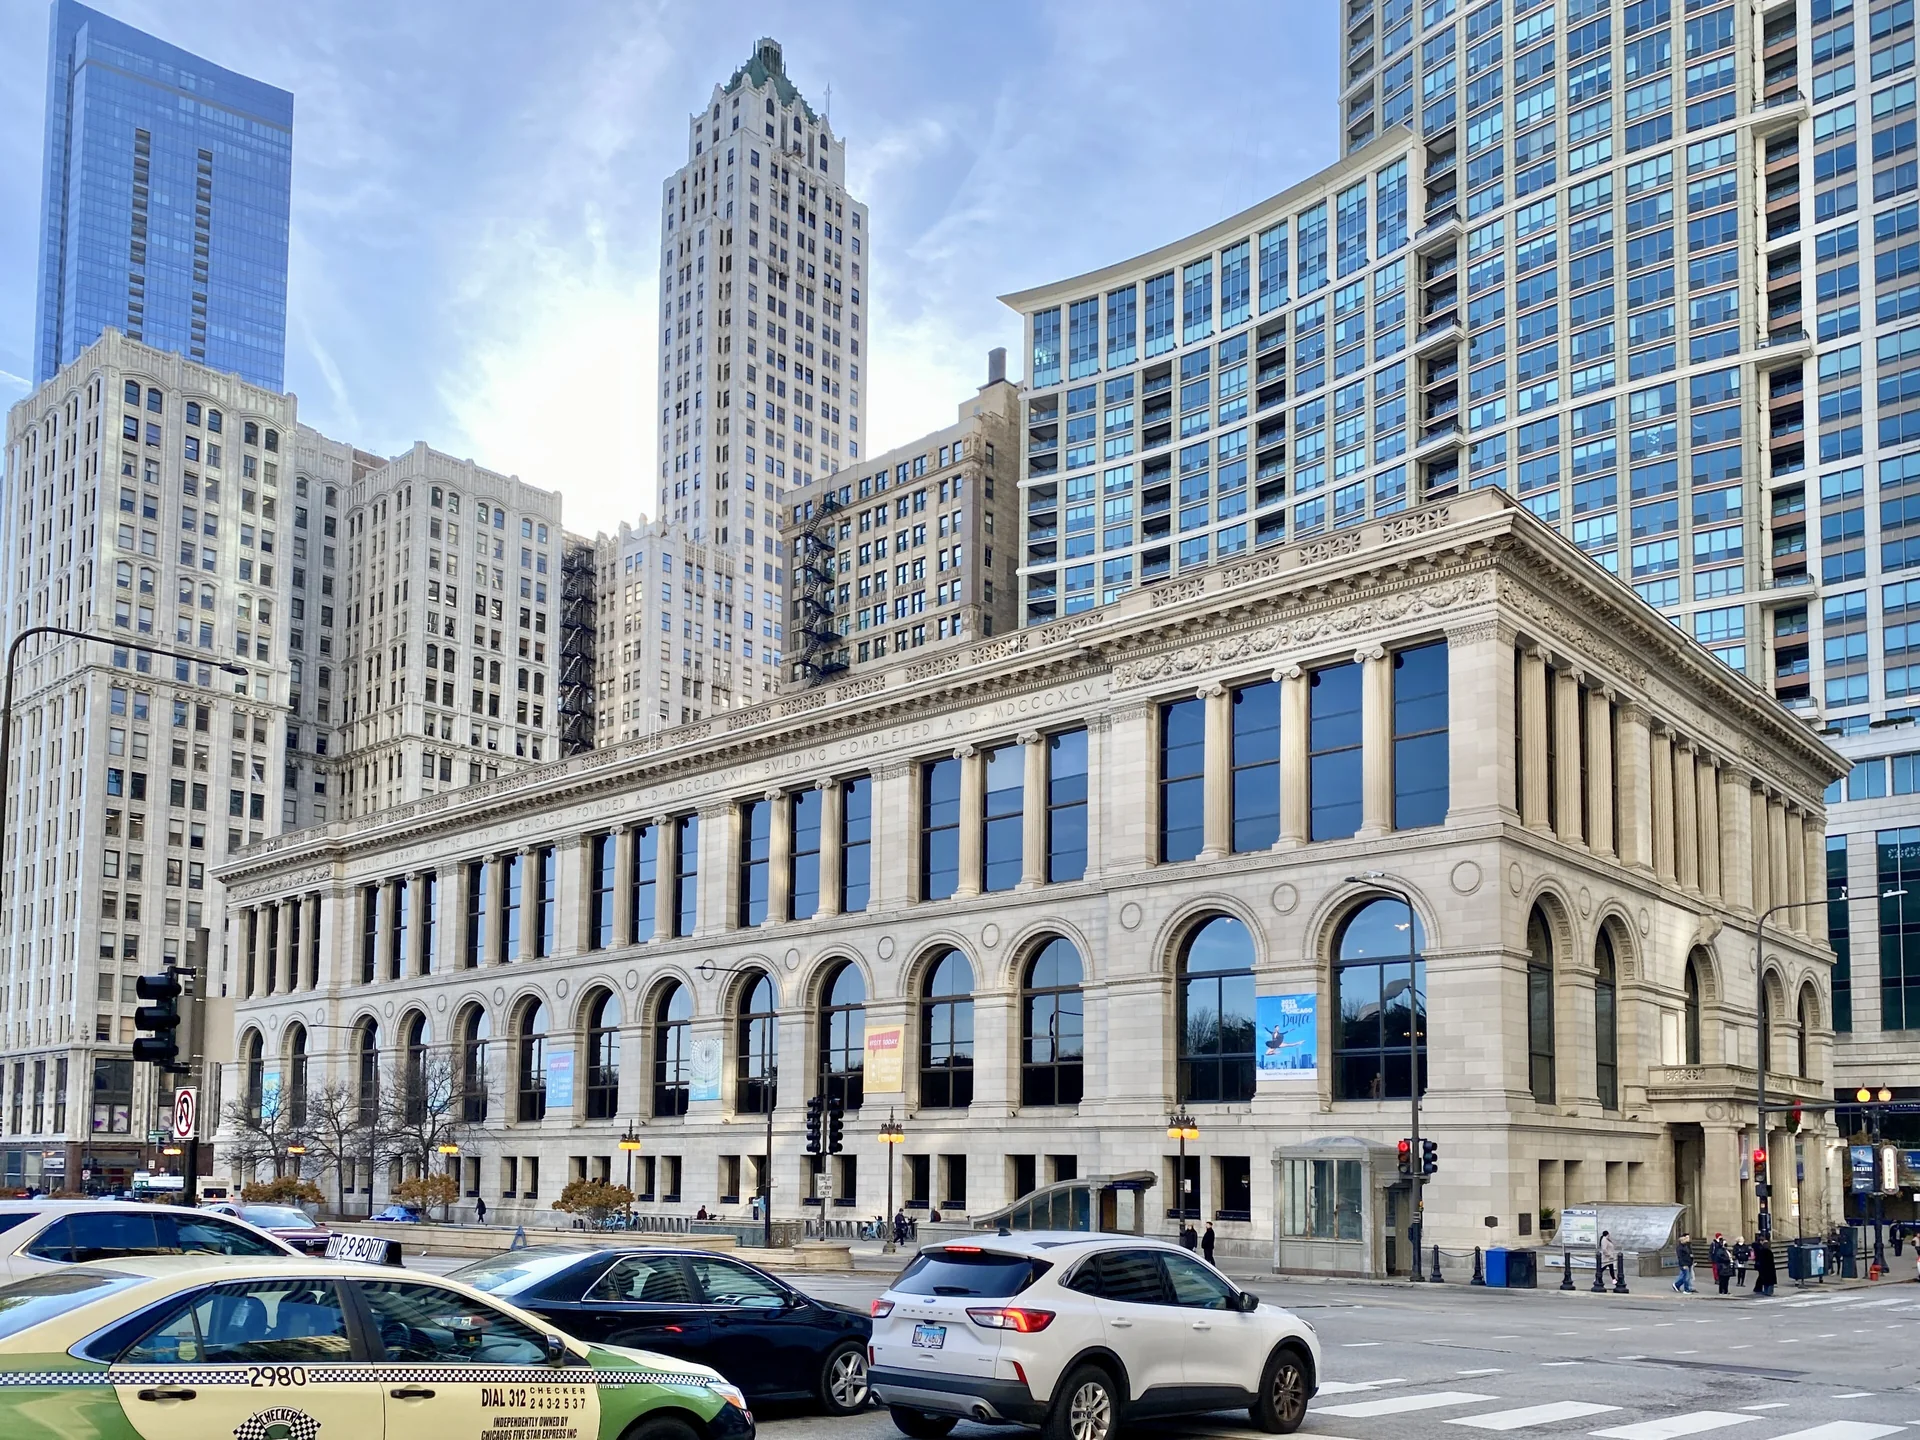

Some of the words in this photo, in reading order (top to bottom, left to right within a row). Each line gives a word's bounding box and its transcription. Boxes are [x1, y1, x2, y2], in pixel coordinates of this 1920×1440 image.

[386, 849, 421, 866] LIBRARY
[427, 843, 438, 855] OF
[444, 836, 461, 851] THE
[468, 829, 491, 845] CITY
[498, 825, 509, 837] OF
[517, 813, 563, 834] CHICAGO
[576, 797, 626, 820] FOVNDED
[764, 749, 827, 775] BVILDING
[839, 723, 931, 757] COMPLETED
[339, 1235, 371, 1258] 2980
[248, 1366, 307, 1388] 2980
[481, 1388, 506, 1407] DIAL
[509, 1388, 526, 1407] 312
[529, 1387, 586, 1395] CHECKER
[258, 1408, 299, 1426] CHECKER
[493, 1416, 538, 1428] INDEPENDENTLY
[539, 1416, 560, 1427] OWNED
[560, 1416, 569, 1427] BY
[481, 1430, 513, 1440] CHICAGOS
[513, 1429, 526, 1440] FIVE
[525, 1429, 541, 1440] STAR
[541, 1428, 567, 1439] EXPRESS
[567, 1428, 578, 1439] INC
